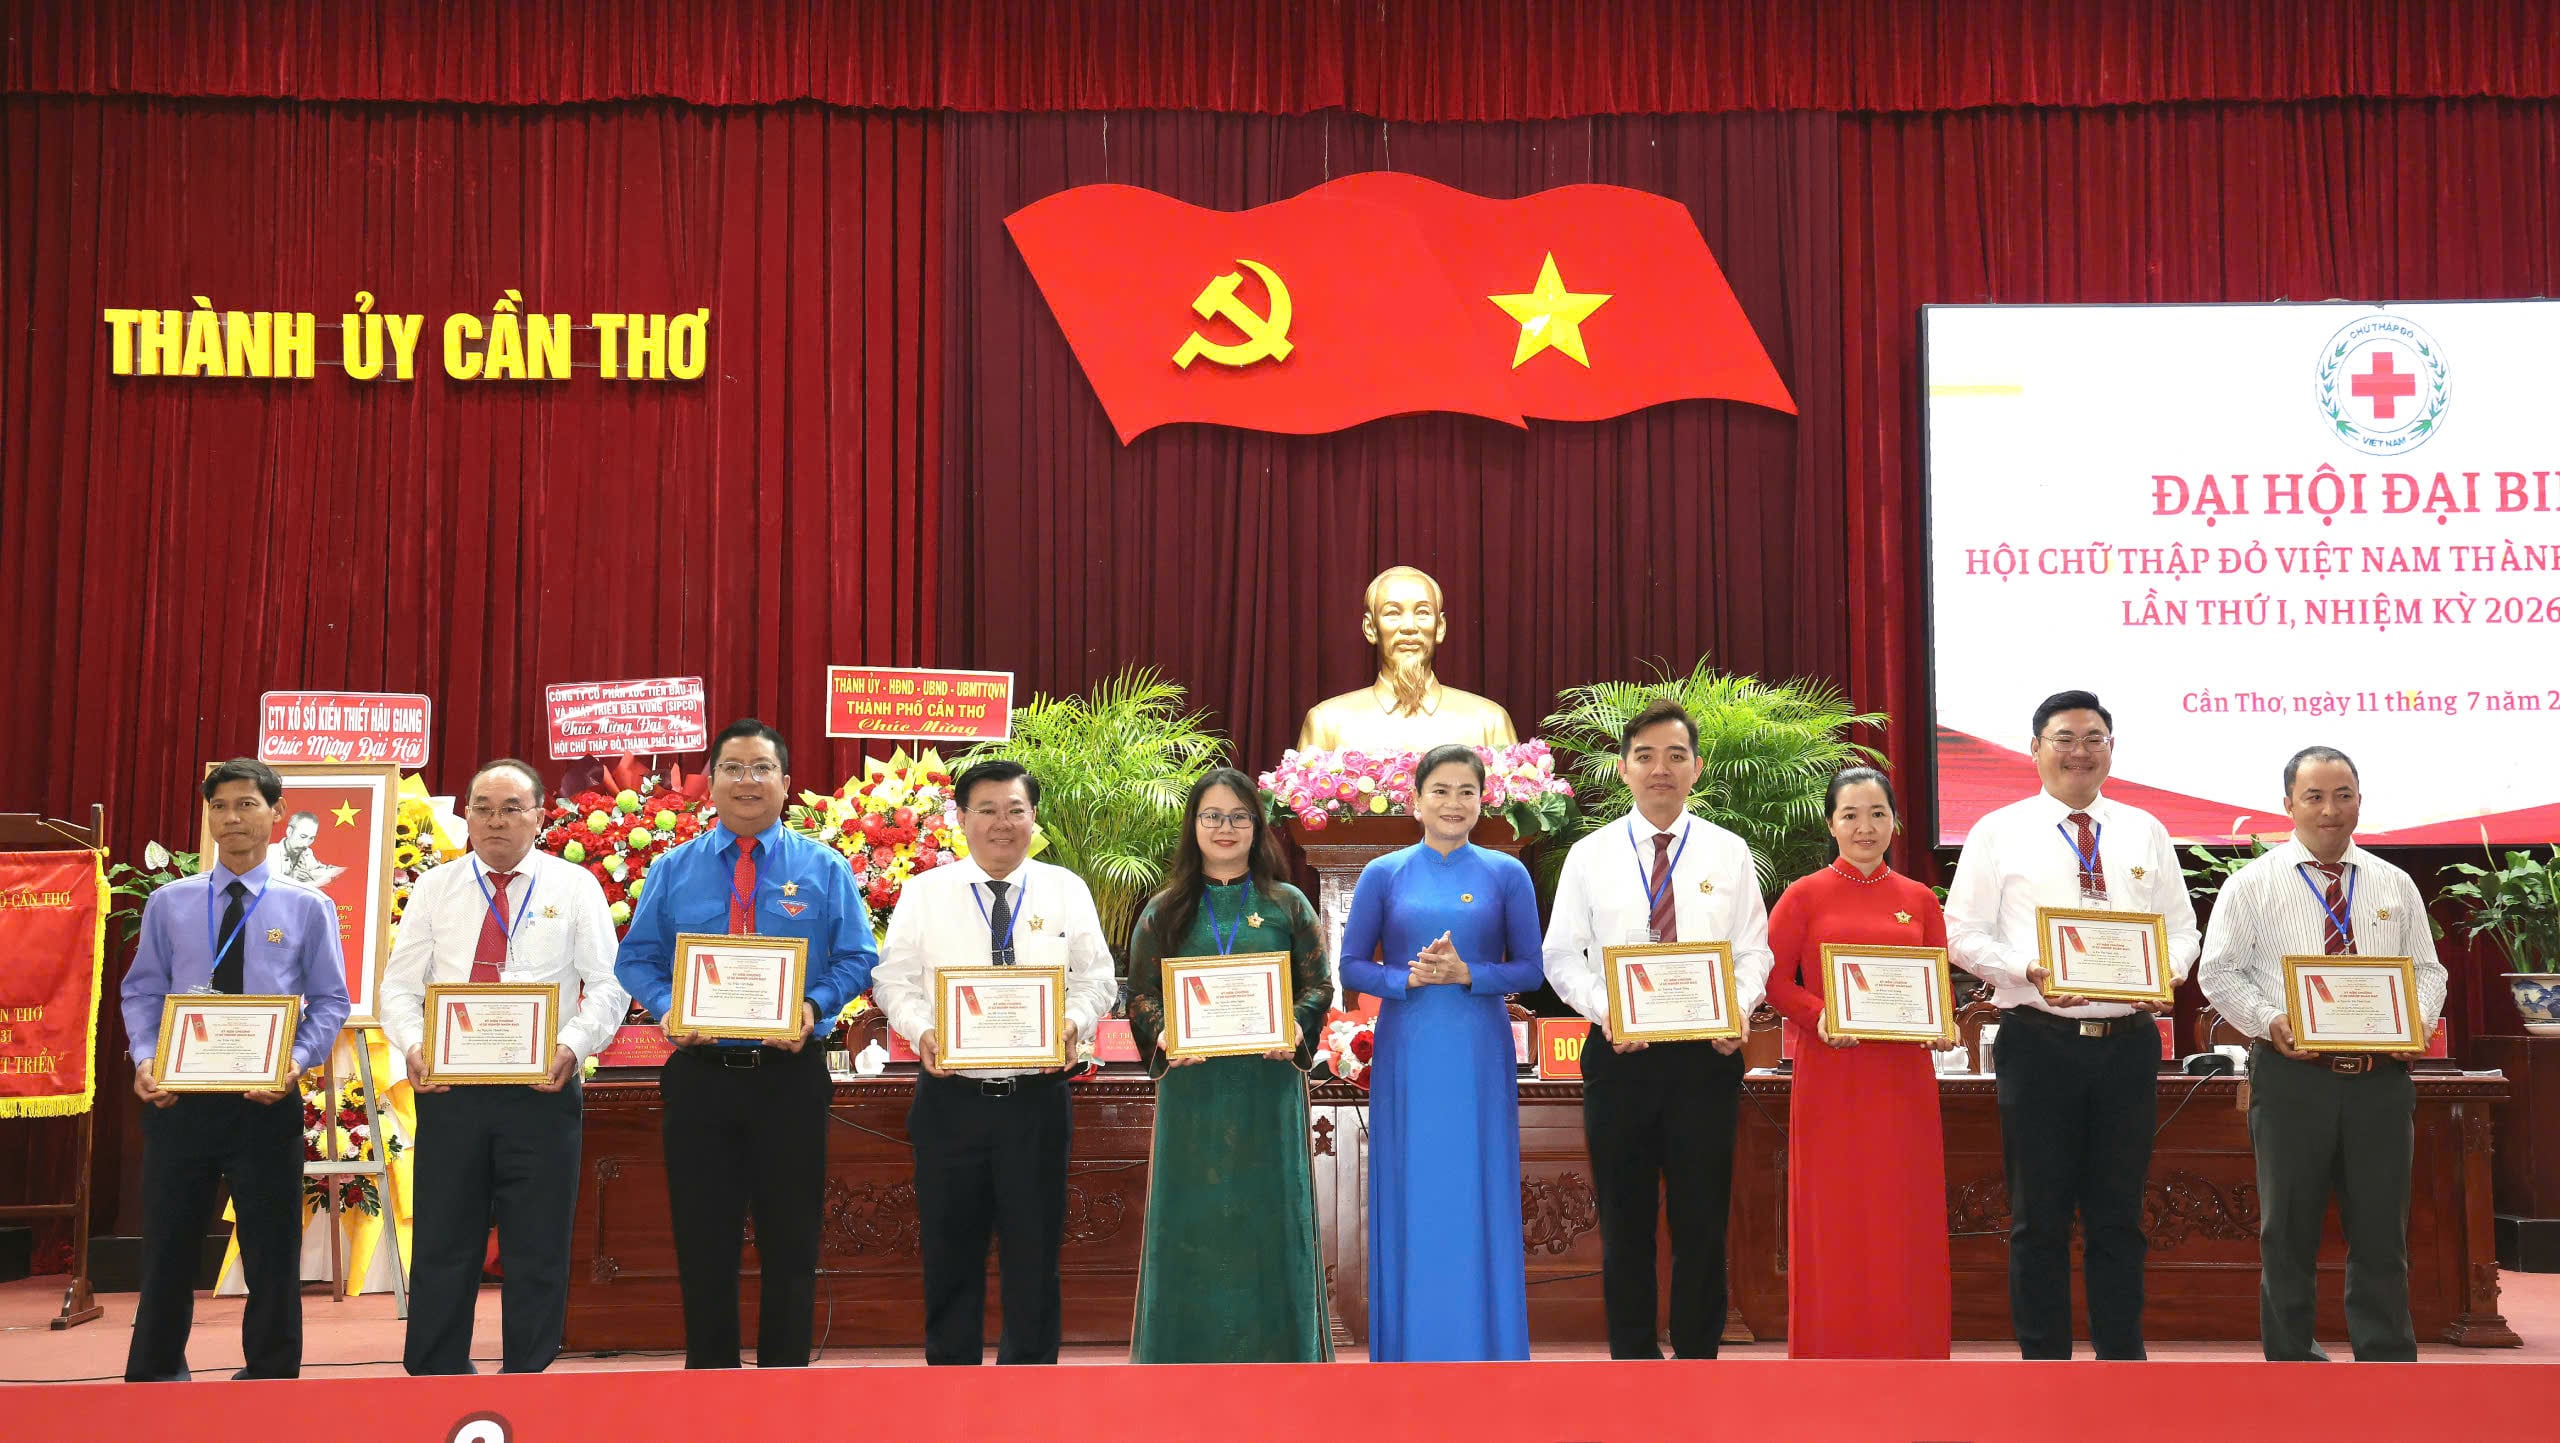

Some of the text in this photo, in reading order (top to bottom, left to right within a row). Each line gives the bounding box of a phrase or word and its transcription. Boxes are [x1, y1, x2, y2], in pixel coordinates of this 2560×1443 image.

[104, 289, 710, 380] THÀNH ỦY CẦN THƠ
[2151, 462, 2560, 528] ĐẠI HỘI ĐẠI BI
[1965, 542, 2030, 583] HỘI
[2038, 541, 2113, 575] CHỮ
[2117, 541, 2210, 582] THẬP
[2218, 539, 2268, 575] ĐỎ
[2274, 540, 2353, 581] VIỆT
[2361, 545, 2441, 573] NAM
[2122, 587, 2560, 632] LẦN THỨ I, NHIỆM KỲ 2026
[549, 688, 573, 702] CÔNG
[575, 687, 586, 700] TY
[834, 674, 865, 694] THÀNH
[868, 672, 881, 695] ỦY
[889, 678, 915, 696] HĐND
[923, 680, 948, 697] UBND
[957, 682, 1007, 701] UBMTTQVN
[666, 699, 697, 714] (SIPCO)
[847, 698, 986, 719] THÀNH PHỐ CẦN THƠ
[2182, 687, 2230, 713] Cần
[2235, 691, 2287, 716] Thơ,
[2292, 691, 2351, 717] ngày
[2357, 691, 2378, 712] 11
[2385, 690, 2457, 715] tháng
[2467, 691, 2480, 712] 7
[2485, 690, 2541, 712] năm
[268, 697, 423, 738] CTY XỔ SỐ KIẾN THIẾT HẬU GIANG
[561, 720, 592, 736] Chúc
[594, 717, 632, 736] Mừng
[858, 718, 979, 737] Chúc Mừng
[265, 735, 423, 762] Chúc Mừng Đại Hội
[554, 739, 568, 755] HỘI
[570, 738, 587, 753] CHỮ
[588, 737, 608, 754] THẬP
[12, 889, 38, 907] CẦN
[42, 890, 70, 906] THƠ
[14, 1005, 43, 1022] THƠ
